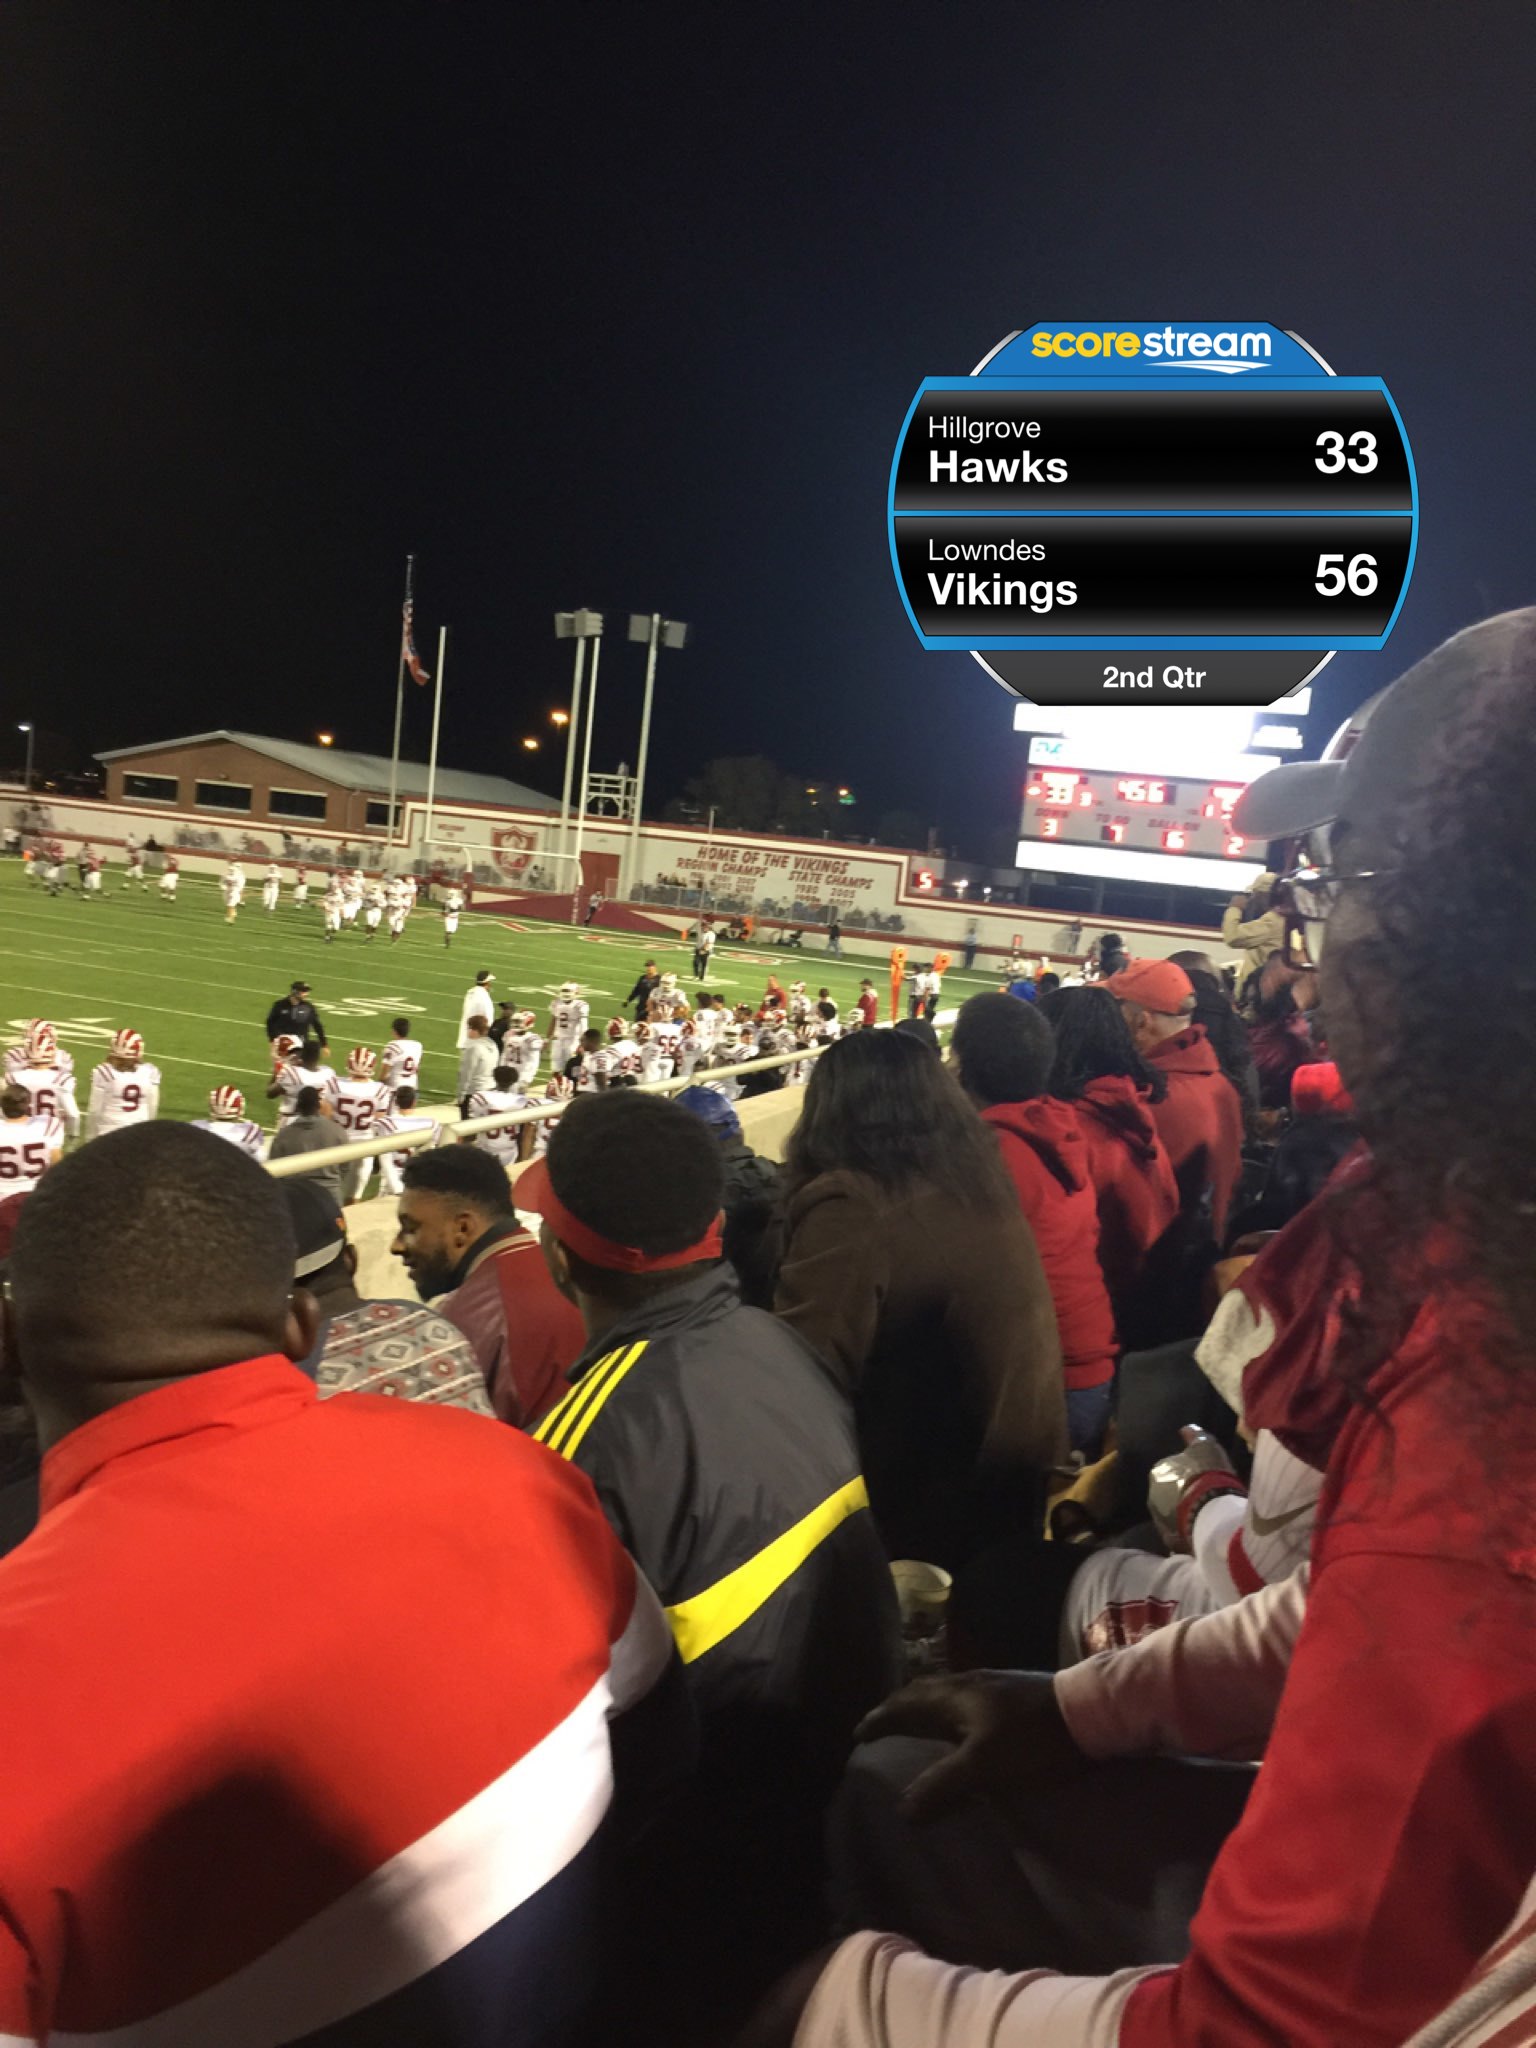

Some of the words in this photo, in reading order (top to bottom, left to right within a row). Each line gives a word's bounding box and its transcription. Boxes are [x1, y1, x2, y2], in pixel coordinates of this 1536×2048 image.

[1227, 836, 1245, 855] 2
[676, 857, 718, 872] REGION
[721, 862, 768, 878] CHAMPS
[697, 846, 740, 862] HOME
[742, 850, 761, 864] OF
[763, 852, 790, 869] THE
[793, 856, 850, 874] VIKINGS
[787, 869, 823, 884] STATE
[824, 873, 875, 890] CHAMPS
[121, 1084, 142, 1113] 9
[336, 1097, 375, 1131] 52
[0, 1142, 47, 1179] 65
